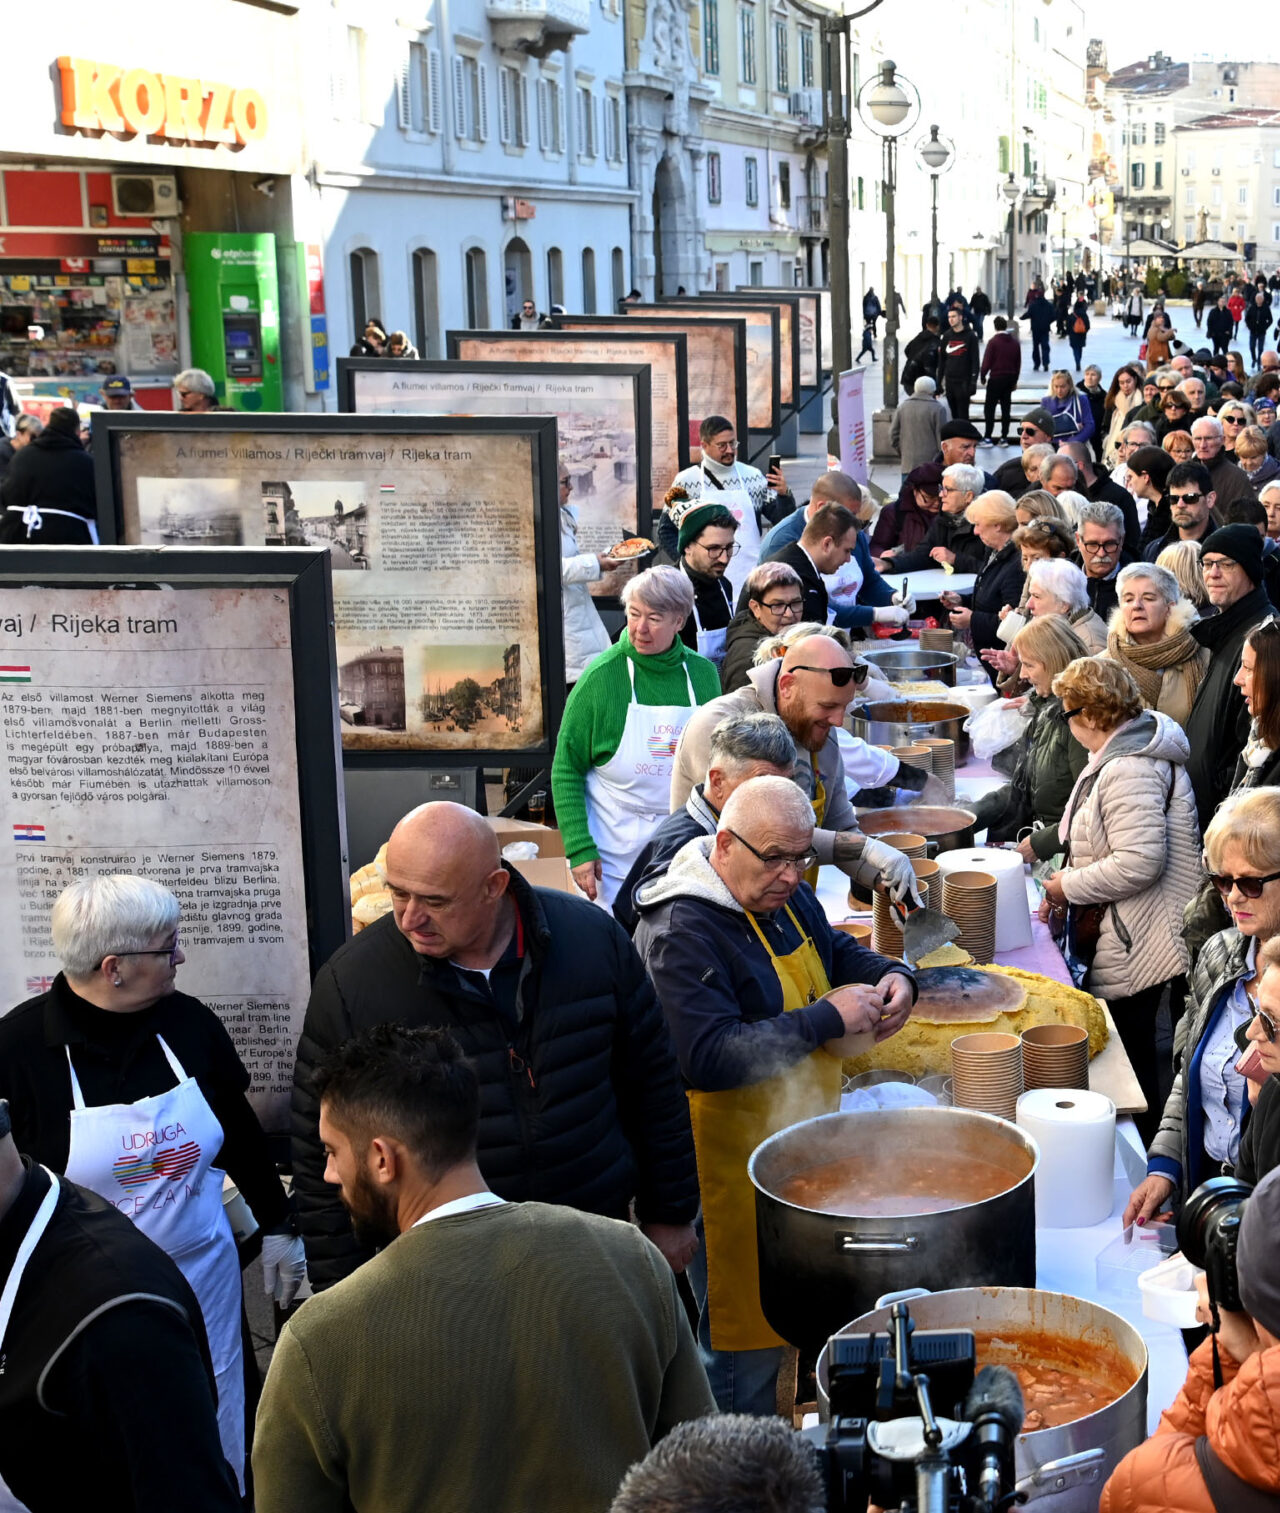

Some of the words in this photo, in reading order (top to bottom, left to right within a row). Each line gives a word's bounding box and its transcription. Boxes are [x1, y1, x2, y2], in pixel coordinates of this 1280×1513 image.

[56, 55, 268, 143] KORZO
[392, 381, 400, 390] A
[575, 384, 594, 393] tram
[176, 448, 186, 458] A
[232, 447, 282, 460] villamos
[294, 447, 336, 462] Riječki
[339, 449, 387, 462] tramvaj
[401, 449, 440, 462] Rijeka
[443, 449, 472, 461] tram
[51, 613, 120, 638] Rijeka
[127, 617, 178, 635] tram
[1, 692, 14, 701] Az
[21, 692, 42, 702] első
[50, 693, 94, 702] villamost
[101, 693, 138, 703] Werner
[146, 693, 192, 703] Siemens
[200, 691, 234, 701] alkotta
[242, 692, 264, 704] meg
[61, 705, 86, 716] majd
[95, 705, 143, 715] 1881-ben
[151, 703, 219, 716] megnyitották
[227, 705, 233, 713] a
[241, 703, 265, 715] világ
[4, 717, 25, 727] első
[125, 720, 131, 728] a
[139, 718, 172, 727] Berlin
[181, 716, 221, 726] melletti
[229, 715, 266, 725] Gross-
[105, 730, 159, 740] 1887-ben
[167, 729, 190, 739] már
[198, 728, 267, 739] Budapesten
[6, 742, 15, 751] is
[75, 745, 94, 754] egy
[171, 742, 197, 752] majd
[206, 740, 254, 750] 1889-ben
[8, 755, 43, 765] magyar
[107, 755, 146, 765] kezdték
[150, 756, 172, 766] meg
[232, 752, 269, 763] Európa
[228, 765, 240, 774] 10
[634, 762, 665, 777] SRCE
[52, 779, 72, 788] már
[80, 779, 131, 789] Fiumében
[138, 780, 147, 788] is
[154, 778, 208, 789] utazhattak
[12, 791, 18, 799] a
[21, 791, 58, 802] gyorsan
[96, 792, 124, 801] város
[16, 852, 35, 863] Prvi
[41, 853, 75, 866] tramvaj
[80, 853, 137, 864] konstruirao
[142, 854, 152, 866] je
[157, 853, 196, 863] Werner
[201, 852, 245, 862] Siemens
[17, 866, 52, 877] godine,
[56, 868, 62, 876] a
[137, 866, 181, 876] otvorena
[186, 866, 195, 876] je
[200, 865, 222, 876] prva
[226, 863, 280, 875] tramvajska
[17, 879, 40, 888] linija
[157, 877, 208, 888] hterfeldeu
[214, 875, 237, 885] blizu
[243, 875, 280, 885] Berlina.
[196, 888, 251, 899] tramvajska
[253, 887, 281, 898] pruga
[200, 902, 210, 911] je
[213, 900, 258, 911] izgradnja
[260, 901, 281, 910] prve
[211, 911, 251, 922] glavnog
[255, 911, 283, 922] grada
[248, 923, 283, 934] godine,
[193, 936, 245, 946] tramvajem
[258, 936, 284, 944] svom
[246, 1001, 290, 1011] Siemens
[219, 1013, 245, 1024] gural
[248, 1013, 271, 1022] tram
[273, 1013, 291, 1022] line
[228, 1026, 251, 1034] near
[283, 1037, 292, 1046] in
[237, 1048, 247, 1057] of
[249, 1048, 293, 1059] Europe's
[244, 1060, 259, 1069] art
[263, 1060, 274, 1069] of
[277, 1060, 293, 1070] the
[278, 1072, 294, 1081] the
[247, 1085, 266, 1093] am
[121, 1122, 187, 1151] UDRUGA
[152, 1189, 177, 1210] ZA
